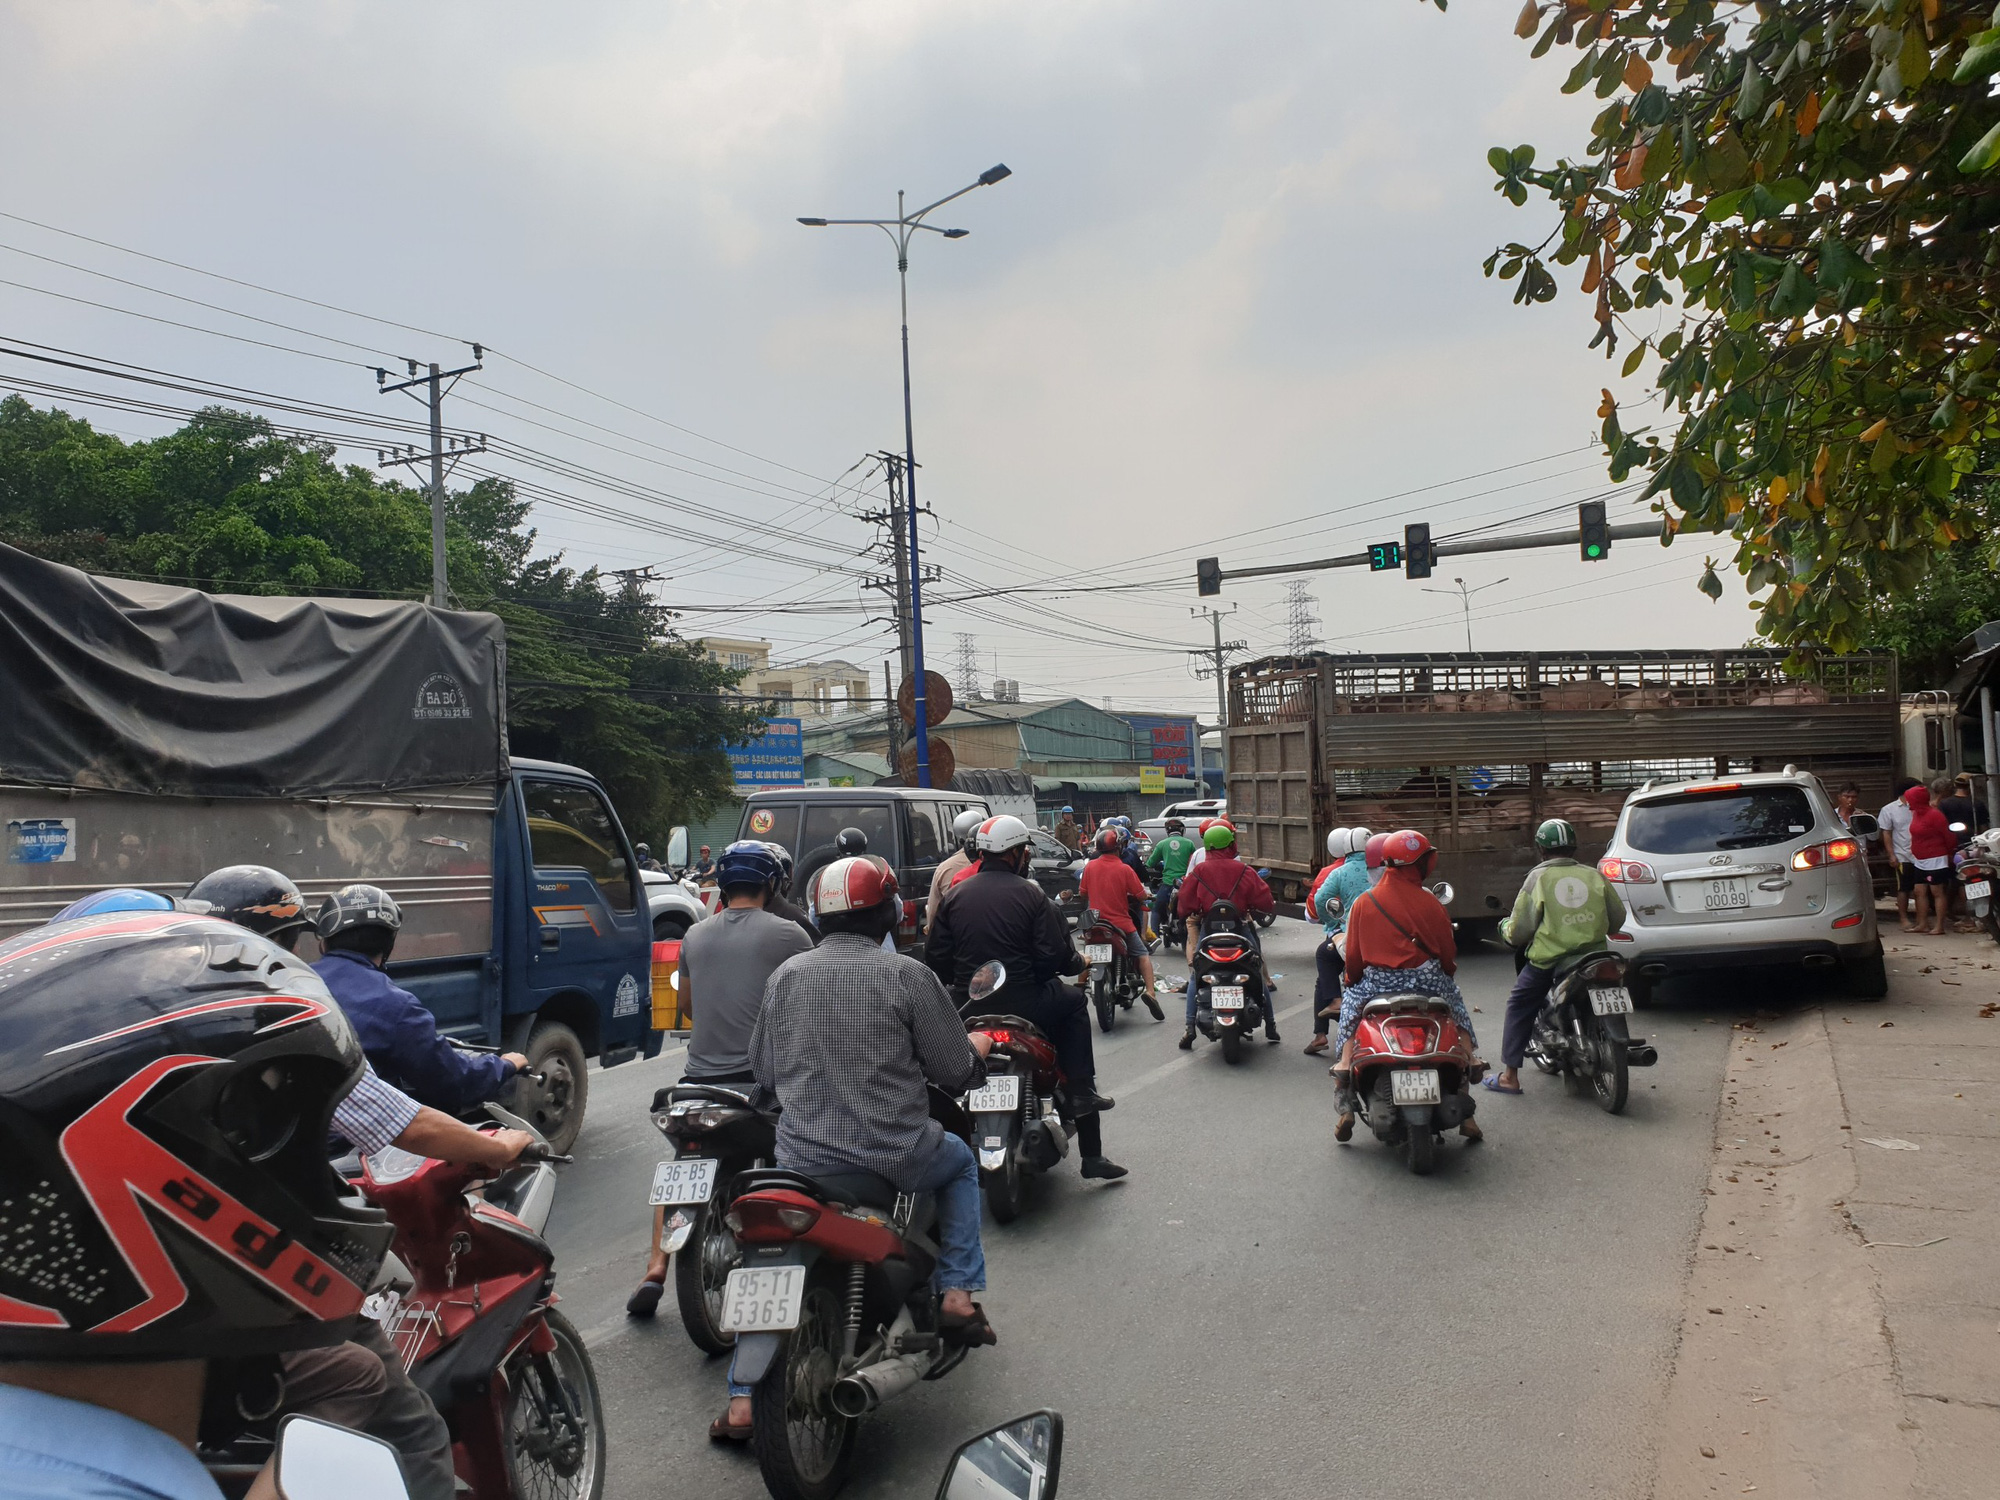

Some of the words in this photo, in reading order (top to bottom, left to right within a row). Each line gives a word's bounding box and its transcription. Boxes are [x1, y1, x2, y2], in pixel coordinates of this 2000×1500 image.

[1374, 546, 1397, 568] 31
[39, 835, 67, 843] TURBO
[1712, 880, 1736, 894] 61A
[1705, 893, 1746, 907] 000.89
[1561, 909, 1596, 925] Grab
[1214, 998, 1242, 1007] 137.05
[1598, 1001, 1627, 1013] 7889
[1400, 1072, 1430, 1087] 48-E1
[973, 1094, 1014, 1109] 465.80
[664, 1163, 707, 1182] 36-B5
[654, 1182, 708, 1202] 991.19
[737, 1271, 793, 1298] 95-T1
[733, 1299, 789, 1326] 5365
